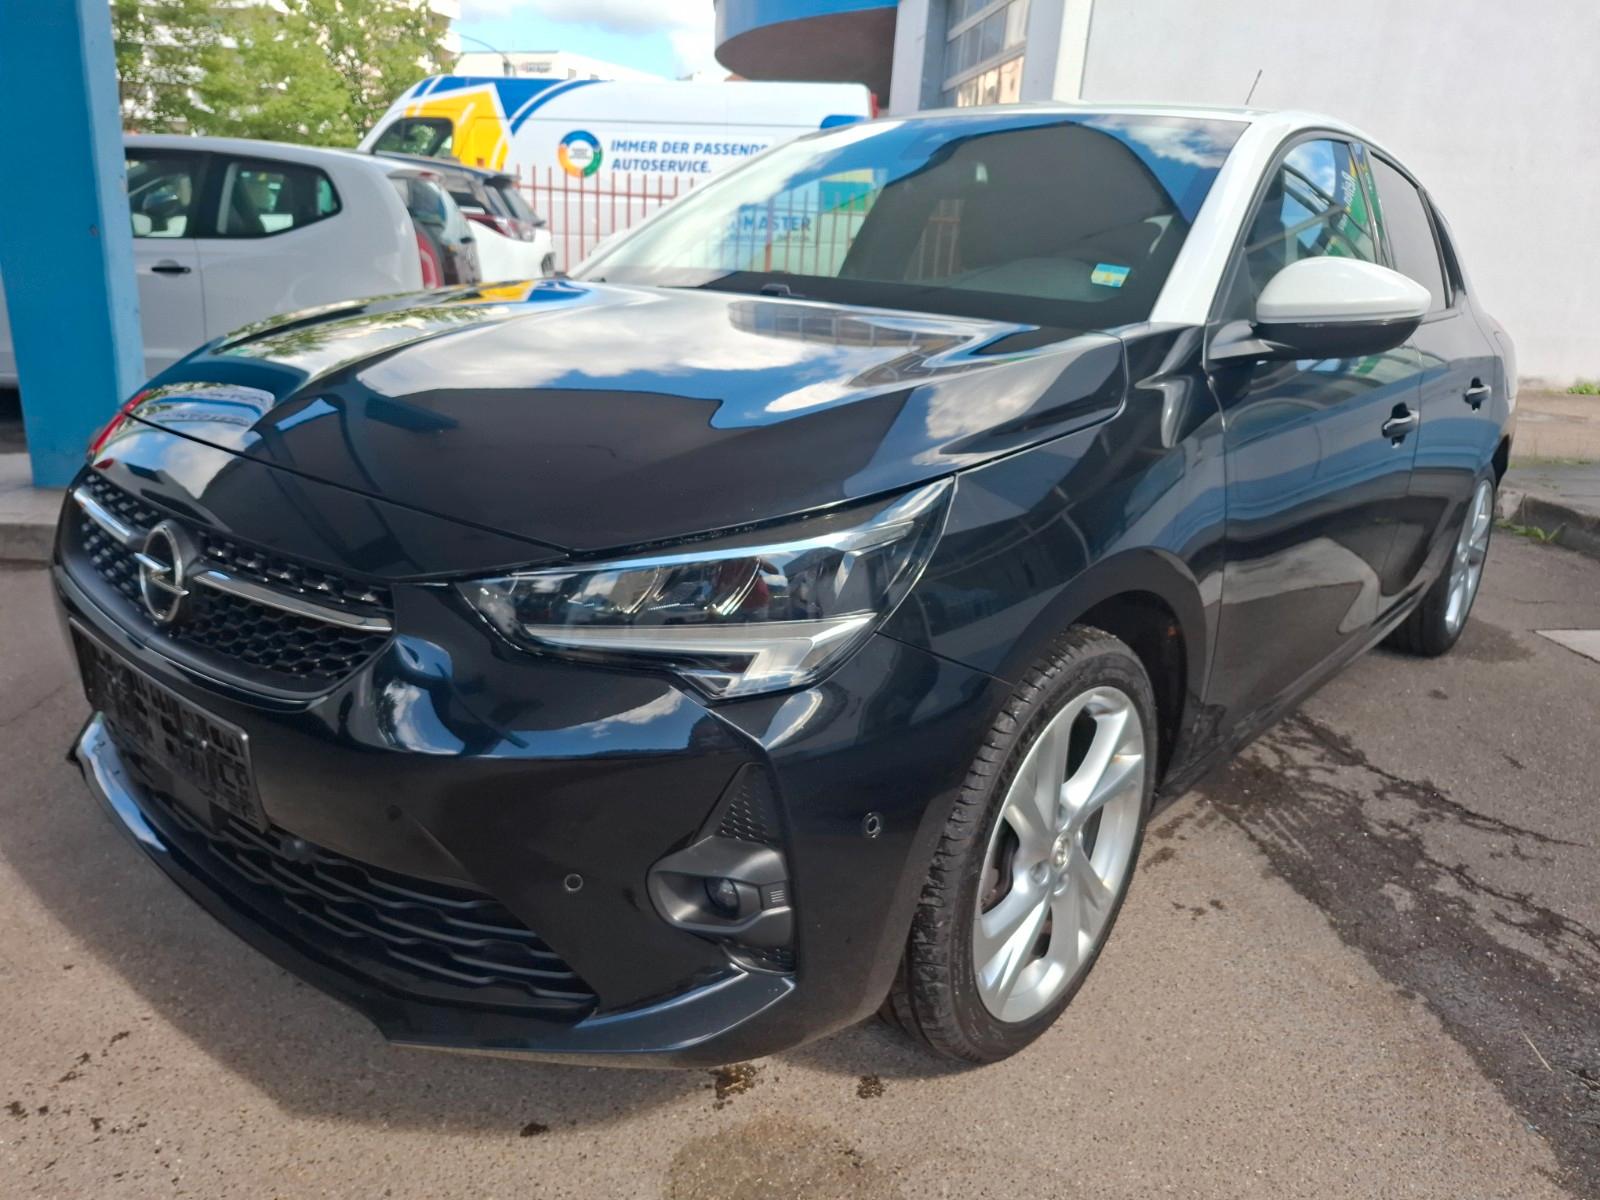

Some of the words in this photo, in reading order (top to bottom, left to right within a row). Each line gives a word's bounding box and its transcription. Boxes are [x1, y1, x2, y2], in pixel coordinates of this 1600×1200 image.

[611, 140, 657, 153] IMMER
[662, 141, 689, 154] DER
[612, 158, 711, 173] AUTOSERVICE.
[731, 215, 811, 231] MASTER
